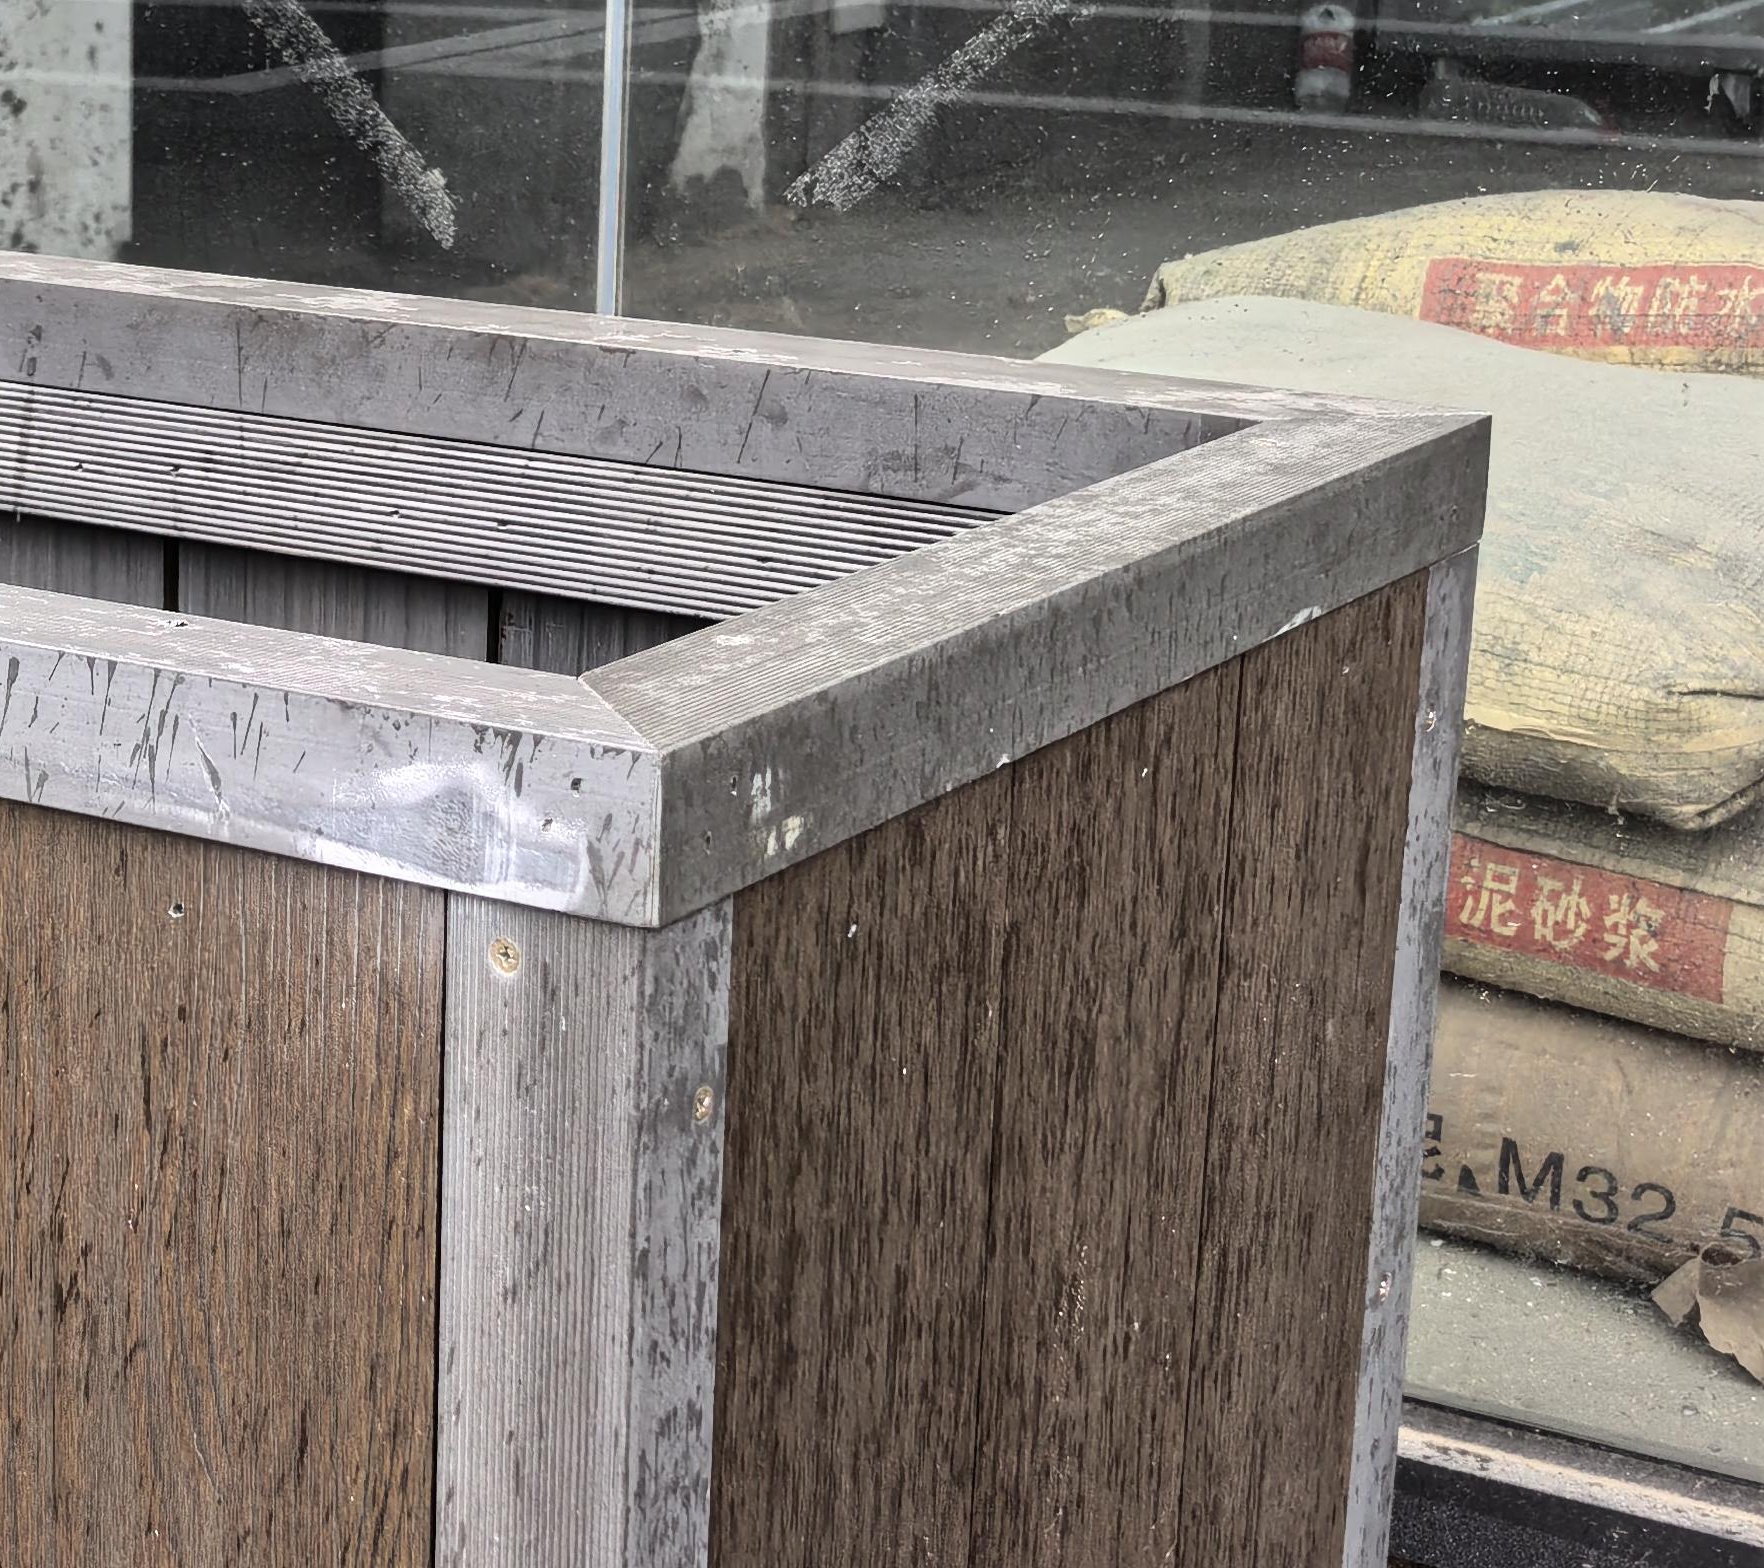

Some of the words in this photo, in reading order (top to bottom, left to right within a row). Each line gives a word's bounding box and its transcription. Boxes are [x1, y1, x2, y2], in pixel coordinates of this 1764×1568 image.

[1458, 855, 1666, 973] 泥砂浆
[1498, 1136, 1764, 1260] M325
